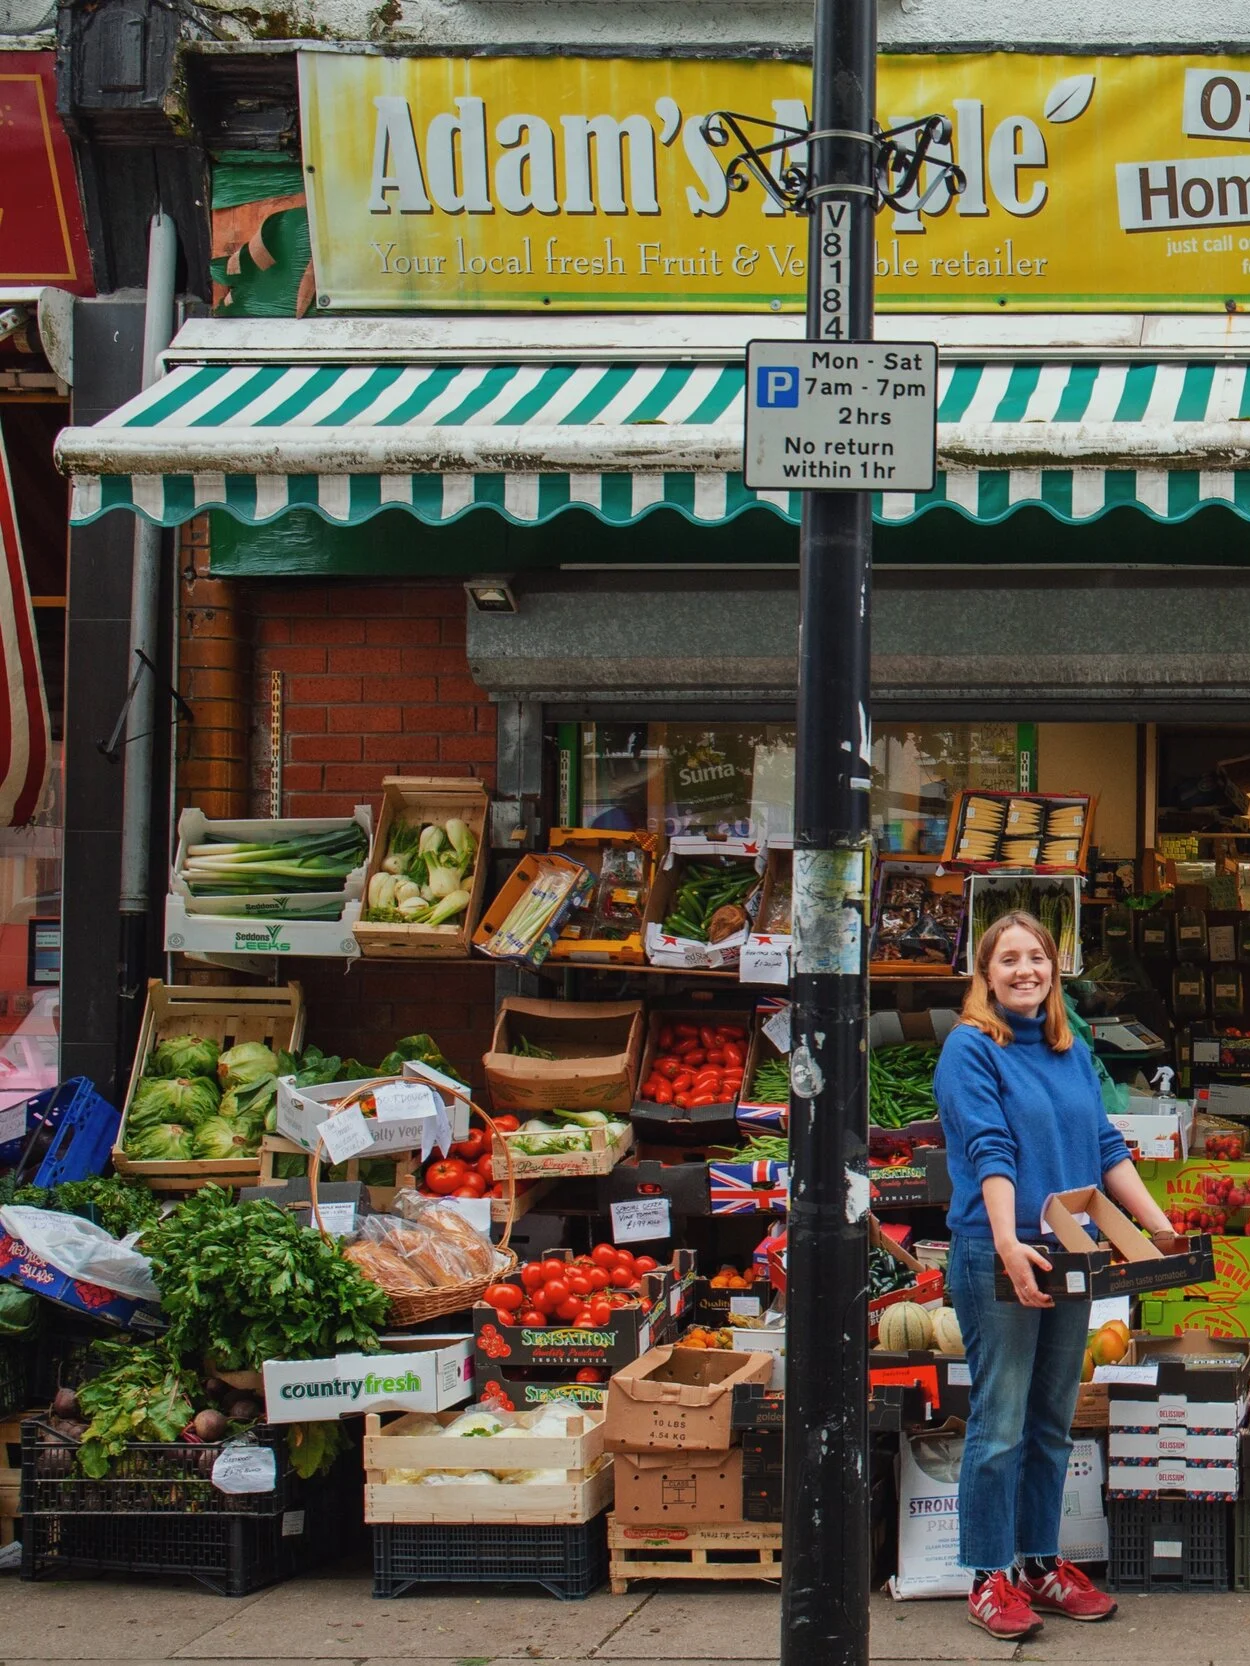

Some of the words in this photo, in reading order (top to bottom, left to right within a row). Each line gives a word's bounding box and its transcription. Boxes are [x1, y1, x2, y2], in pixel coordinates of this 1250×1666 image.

[369, 97, 729, 217] Adam’s
[762, 98, 1048, 234] Aple
[1166, 237, 1198, 257] just
[1203, 235, 1232, 252] call
[371, 242, 446, 275] Your
[456, 236, 533, 275] local
[544, 236, 625, 276] fresh
[637, 242, 722, 276] Fruit
[731, 243, 759, 276] &
[766, 238, 918, 277] Veble
[930, 238, 1047, 277] retailer
[812, 352, 858, 369] Mon
[884, 352, 922, 371] Sat
[785, 437, 815, 455] No
[824, 438, 894, 456] return
[783, 461, 851, 479] within
[678, 763, 737, 787] Suma
[235, 931, 271, 942] Seddons
[235, 941, 291, 951] LEEKS
[1109, 1278, 1135, 1292] golden
[1136, 1275, 1154, 1287] taste
[1155, 1269, 1188, 1284] tomatoes
[521, 1328, 616, 1347] SENSATION
[653, 1419, 665, 1428] 10
[667, 1419, 686, 1429] LBS
[650, 1431, 670, 1440] 4.54
[672, 1433, 686, 1442] KG
